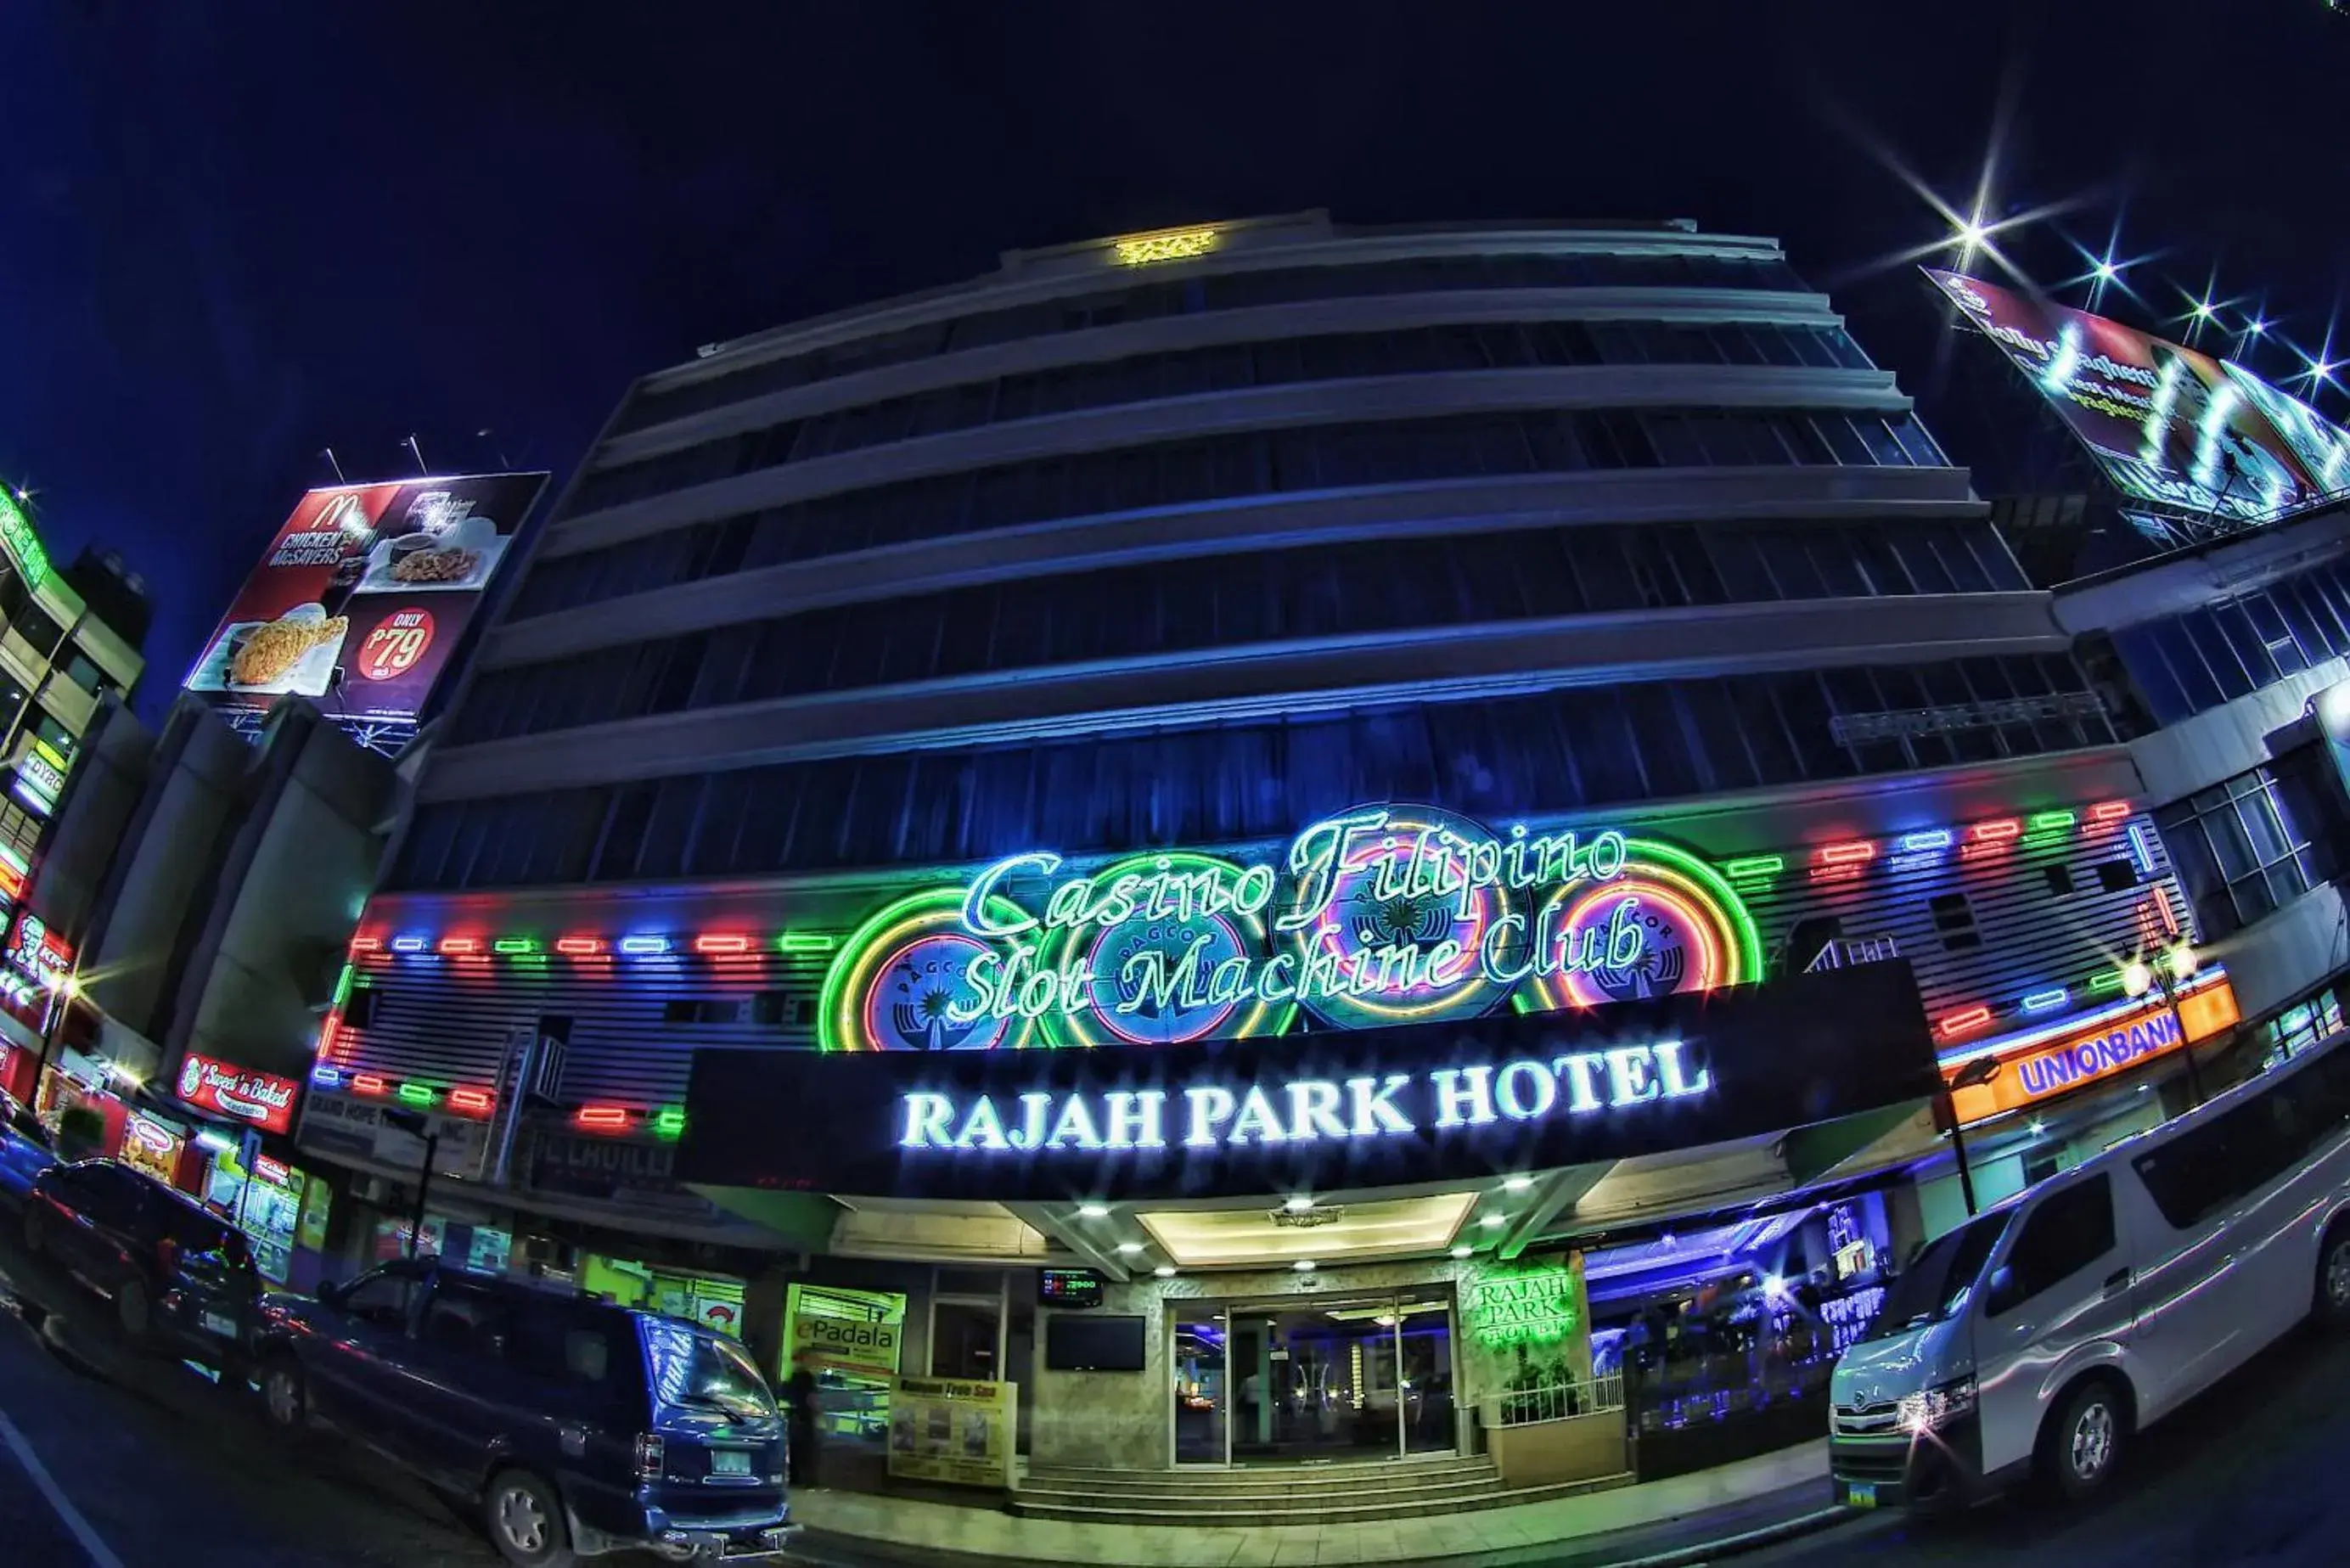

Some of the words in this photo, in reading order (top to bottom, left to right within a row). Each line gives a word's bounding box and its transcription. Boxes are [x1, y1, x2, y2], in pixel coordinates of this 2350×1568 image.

[280, 531, 343, 549] CHICKEN
[393, 613, 424, 627] ONLY
[961, 851, 1275, 936] Casino
[1275, 810, 1628, 930] Filipino
[946, 944, 1093, 1022] Slot
[1115, 924, 1464, 1014] Machine
[1481, 896, 1644, 983] Club
[897, 960, 968, 993] PAGCO
[2018, 1010, 2182, 1095] UNIONBANK
[900, 1088, 1167, 1149] RAJAH
[1183, 1074, 1416, 1146] PARK
[1430, 1039, 1712, 1129] HOTEL
[1481, 1276, 1566, 1306] RAJAH
[1489, 1297, 1560, 1324] PARK
[796, 1320, 893, 1348] ePadala
[1481, 1320, 1564, 1342] HOTEL
